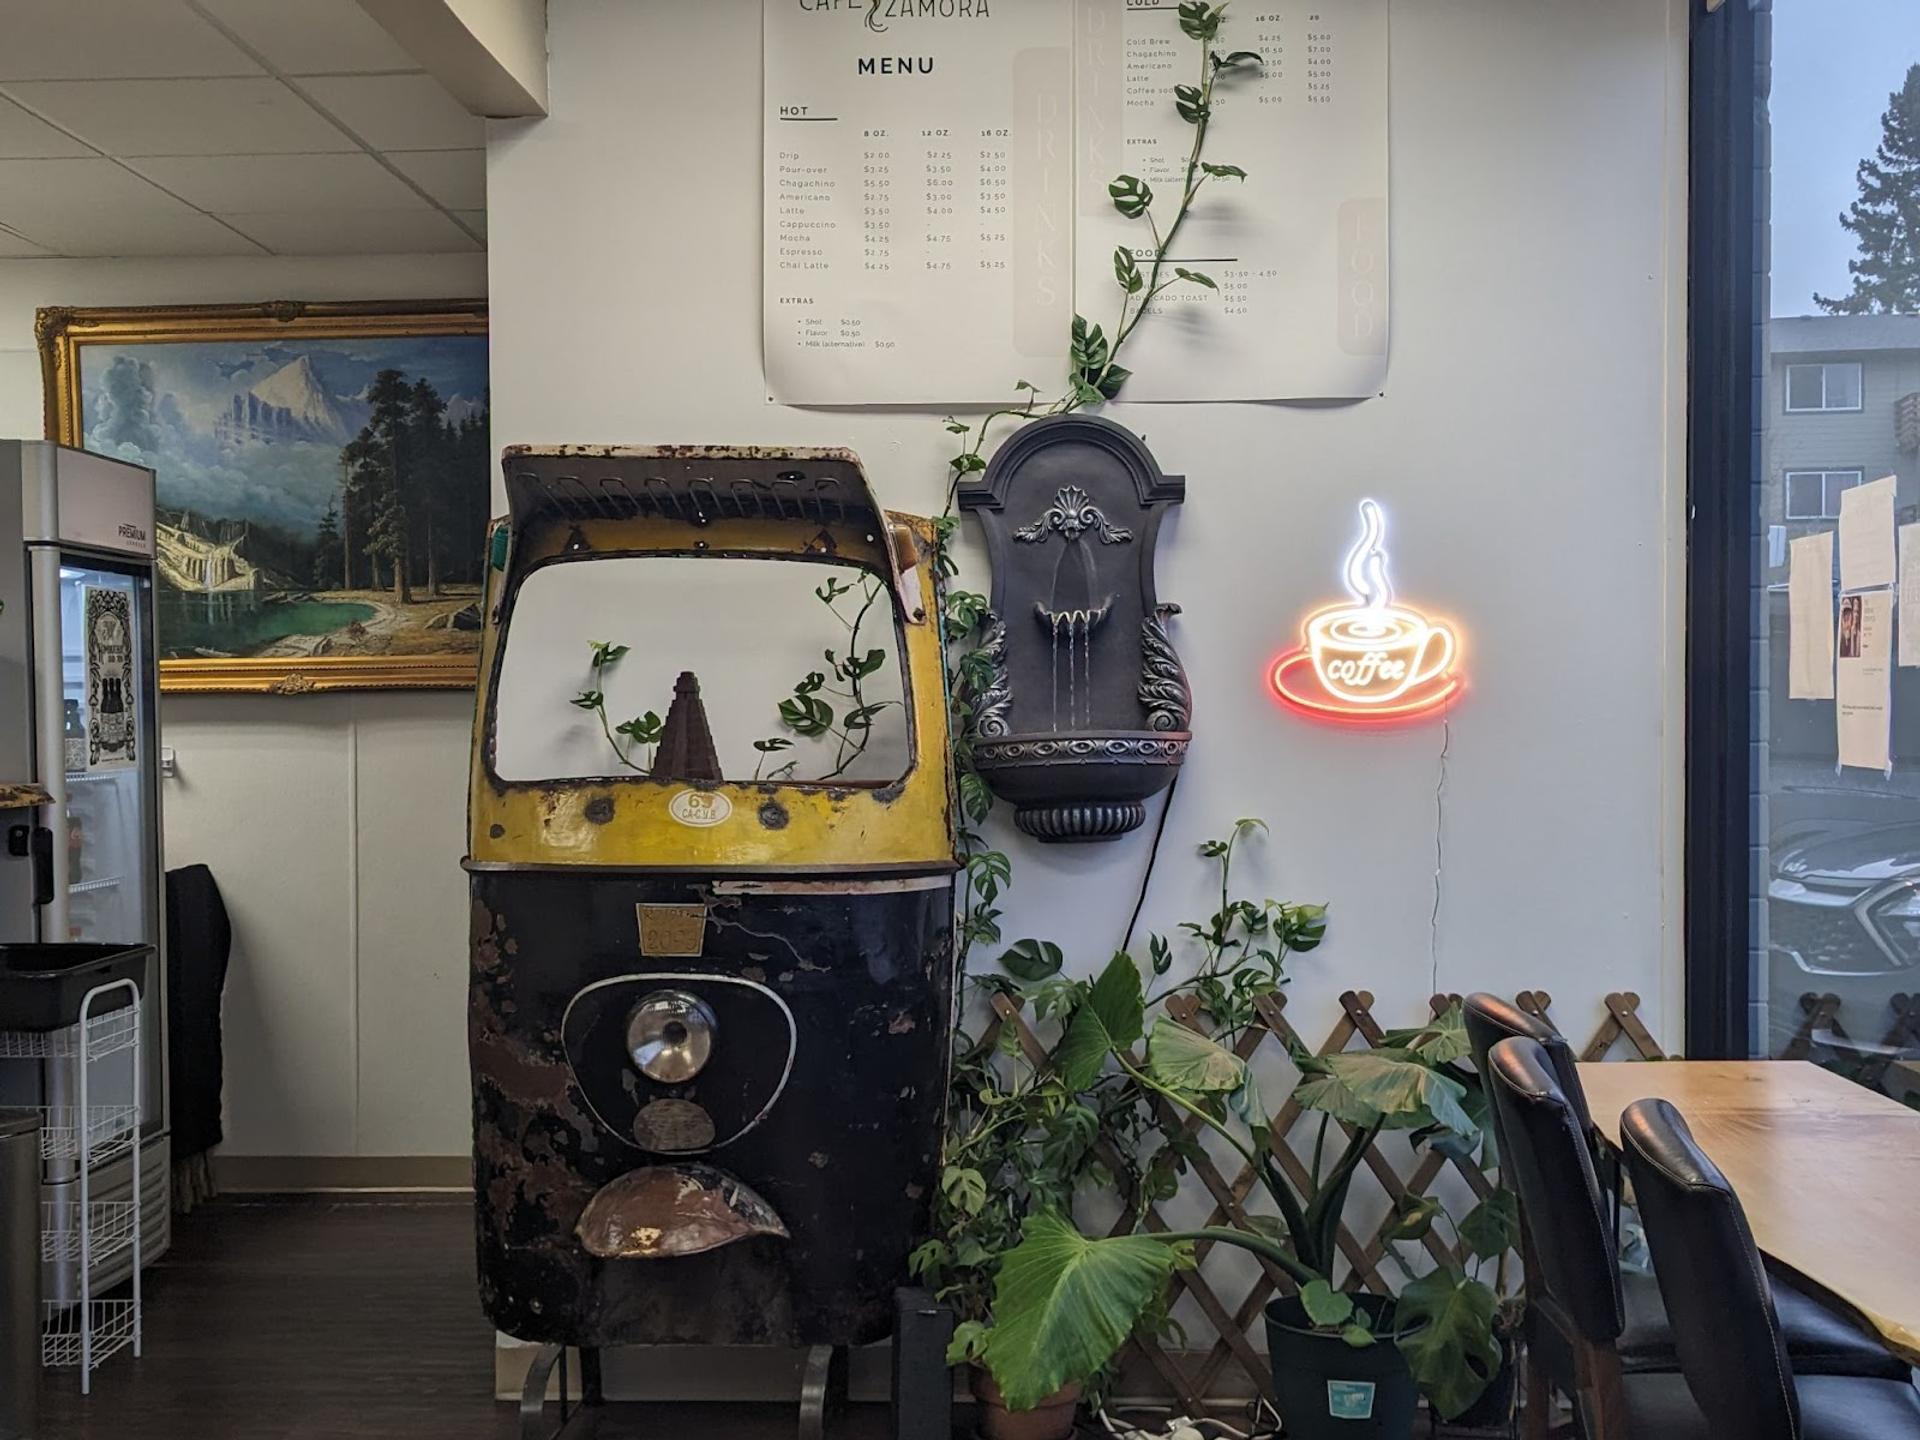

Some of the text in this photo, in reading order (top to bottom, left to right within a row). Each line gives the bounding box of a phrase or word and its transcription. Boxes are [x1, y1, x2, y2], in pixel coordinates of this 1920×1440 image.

[858, 57, 934, 75] MENU
[1126, 86, 1156, 94] Coffee
[1126, 99, 1155, 107] Mocha
[780, 106, 809, 116] HOT
[779, 151, 800, 161] Drip
[779, 165, 828, 174] Pour-over
[779, 179, 836, 189] Chagachino
[779, 193, 831, 202] Americano
[779, 207, 805, 215] Latte
[779, 220, 837, 230] Cappuccino
[779, 234, 811, 242] Mocha
[779, 247, 824, 257] Espresso
[779, 261, 830, 270] Chai Latte
[779, 296, 815, 305] EXTRAS
[804, 318, 823, 326] Shot
[804, 328, 828, 337] Flavor
[804, 339, 820, 348] Milk
[118, 525, 147, 541] PREMIUM
[1327, 651, 1406, 687] coffee
